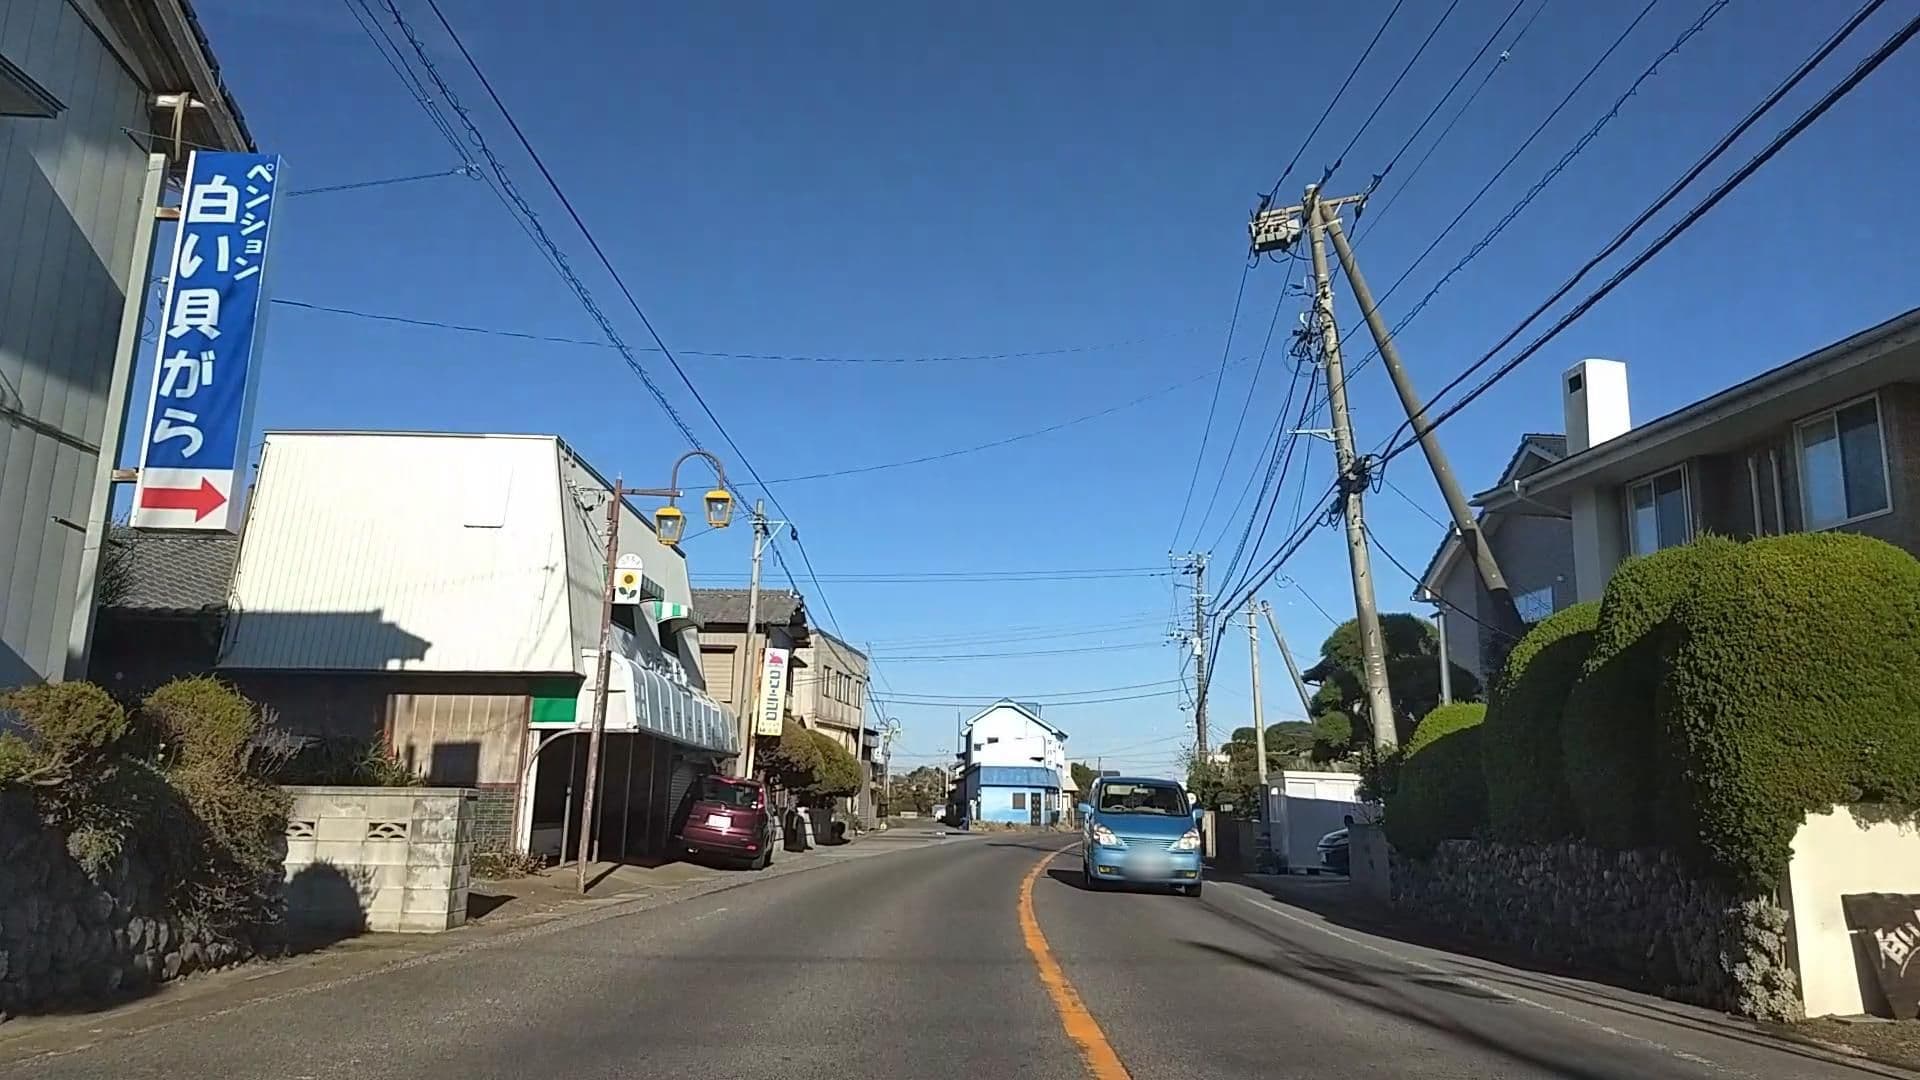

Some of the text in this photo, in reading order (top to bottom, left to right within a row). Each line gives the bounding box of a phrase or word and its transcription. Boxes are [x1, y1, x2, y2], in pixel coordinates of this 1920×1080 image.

[153, 175, 238, 459] 白い貝がら
[234, 163, 273, 281] ペンション
